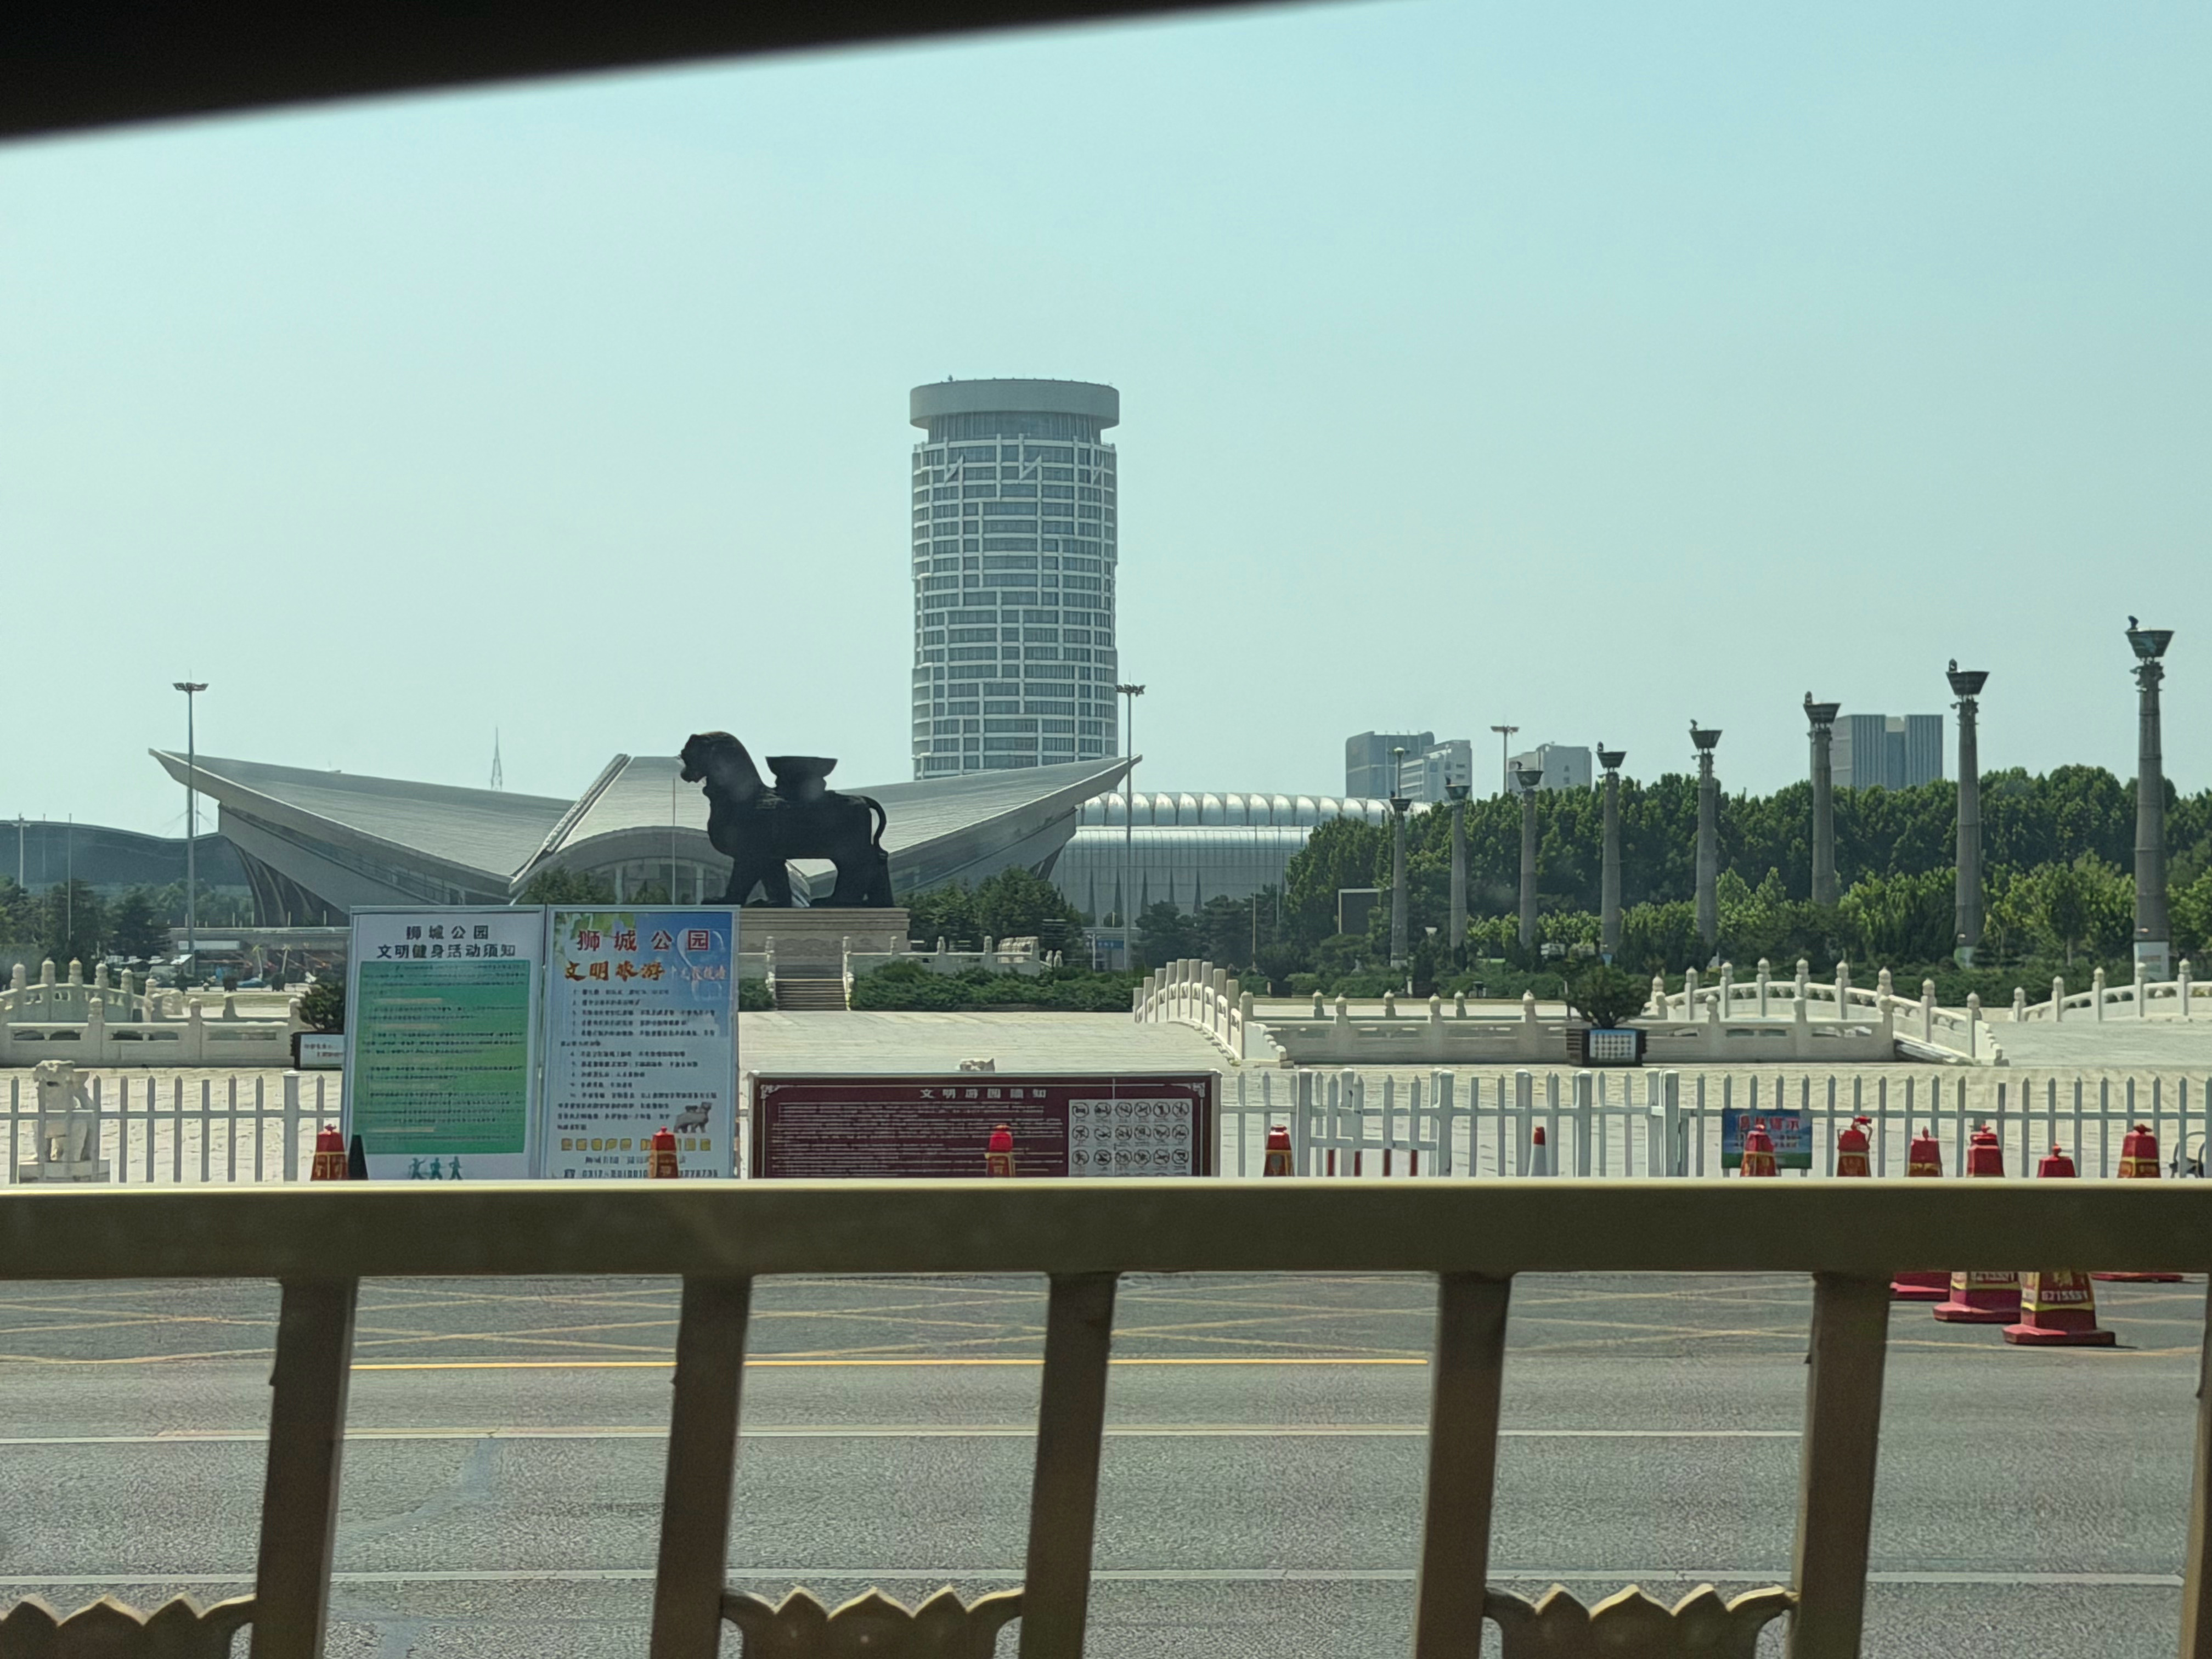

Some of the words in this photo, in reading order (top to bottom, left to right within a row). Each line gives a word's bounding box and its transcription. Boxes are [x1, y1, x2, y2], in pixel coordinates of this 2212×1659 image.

[407, 925, 489, 940] 狮城公园
[577, 929, 709, 951] 狮城公园
[376, 944, 516, 958] 文明健身活动须知
[565, 961, 665, 981] 文明旅游
